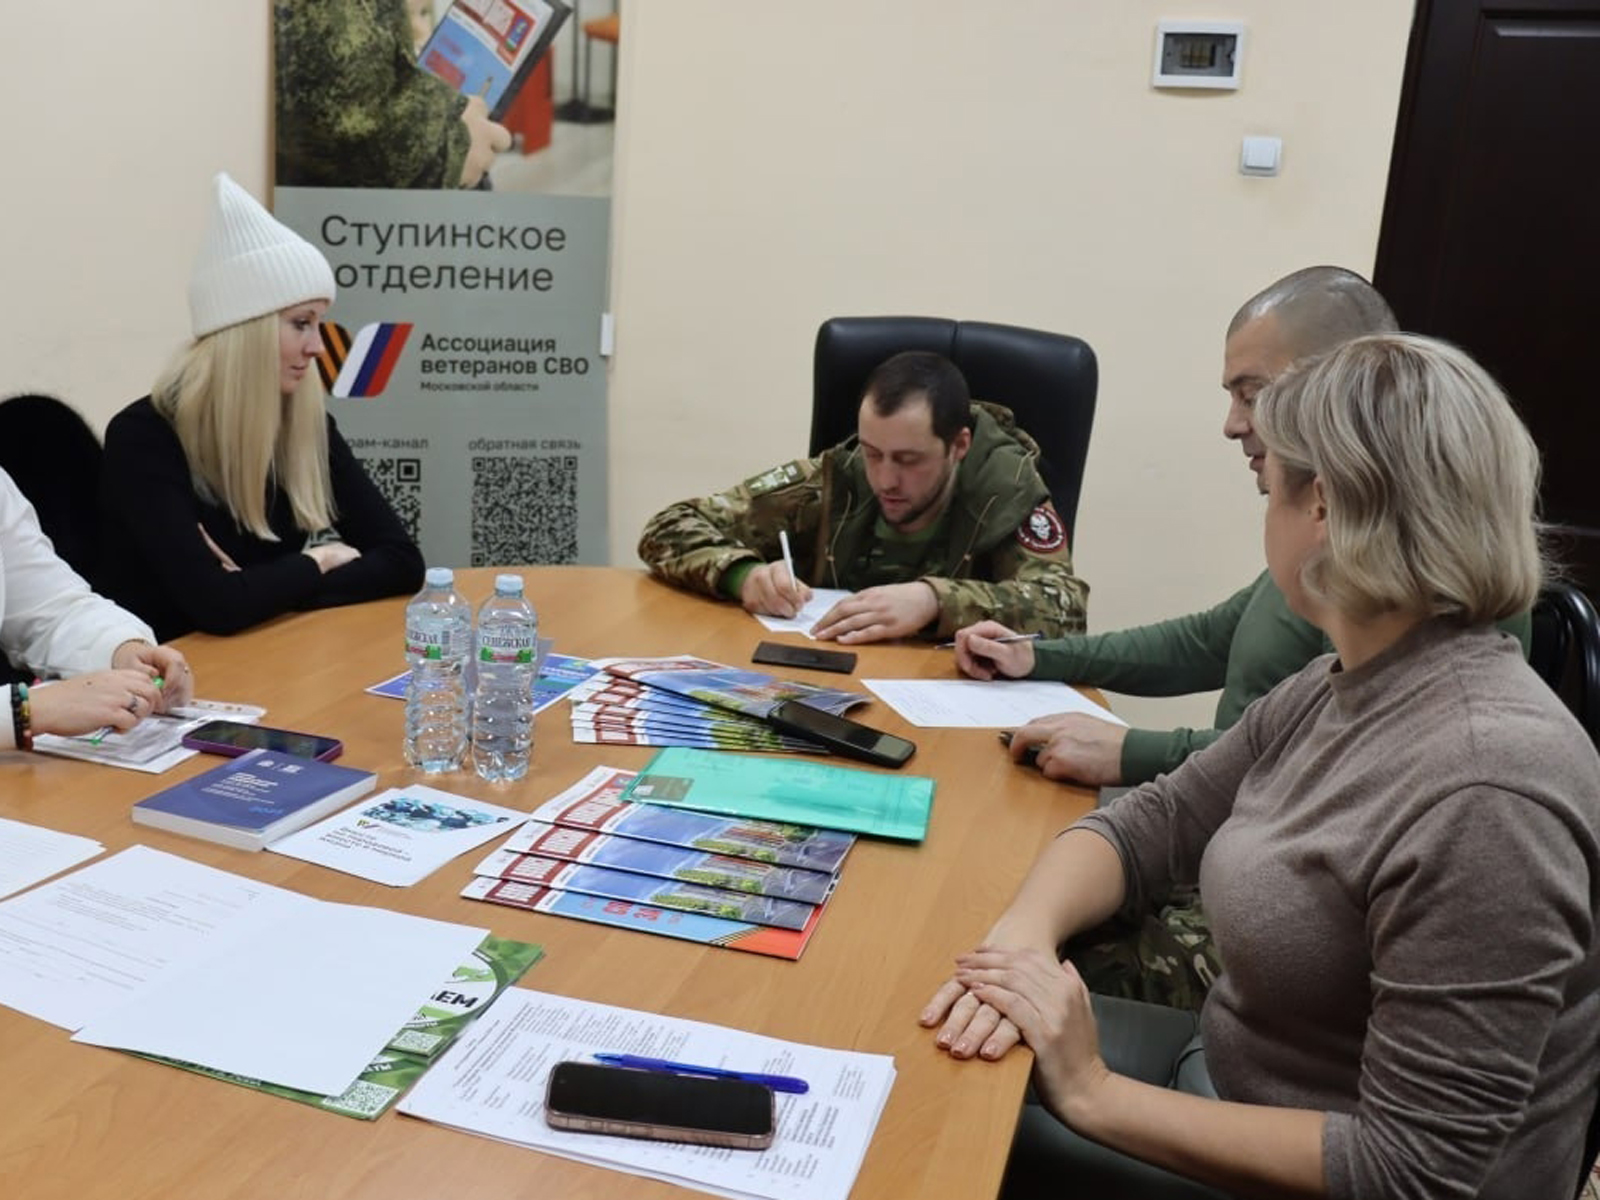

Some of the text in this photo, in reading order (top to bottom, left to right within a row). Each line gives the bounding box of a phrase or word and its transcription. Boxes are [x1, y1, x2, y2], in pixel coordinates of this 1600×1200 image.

[321, 215, 566, 255] Ступинское
[335, 263, 554, 294] отделение
[420, 332, 557, 355] Ассоциация
[420, 356, 590, 379] ветеранов СВО
[420, 382, 539, 392] Московской области
[468, 438, 581, 452] обратная связь
